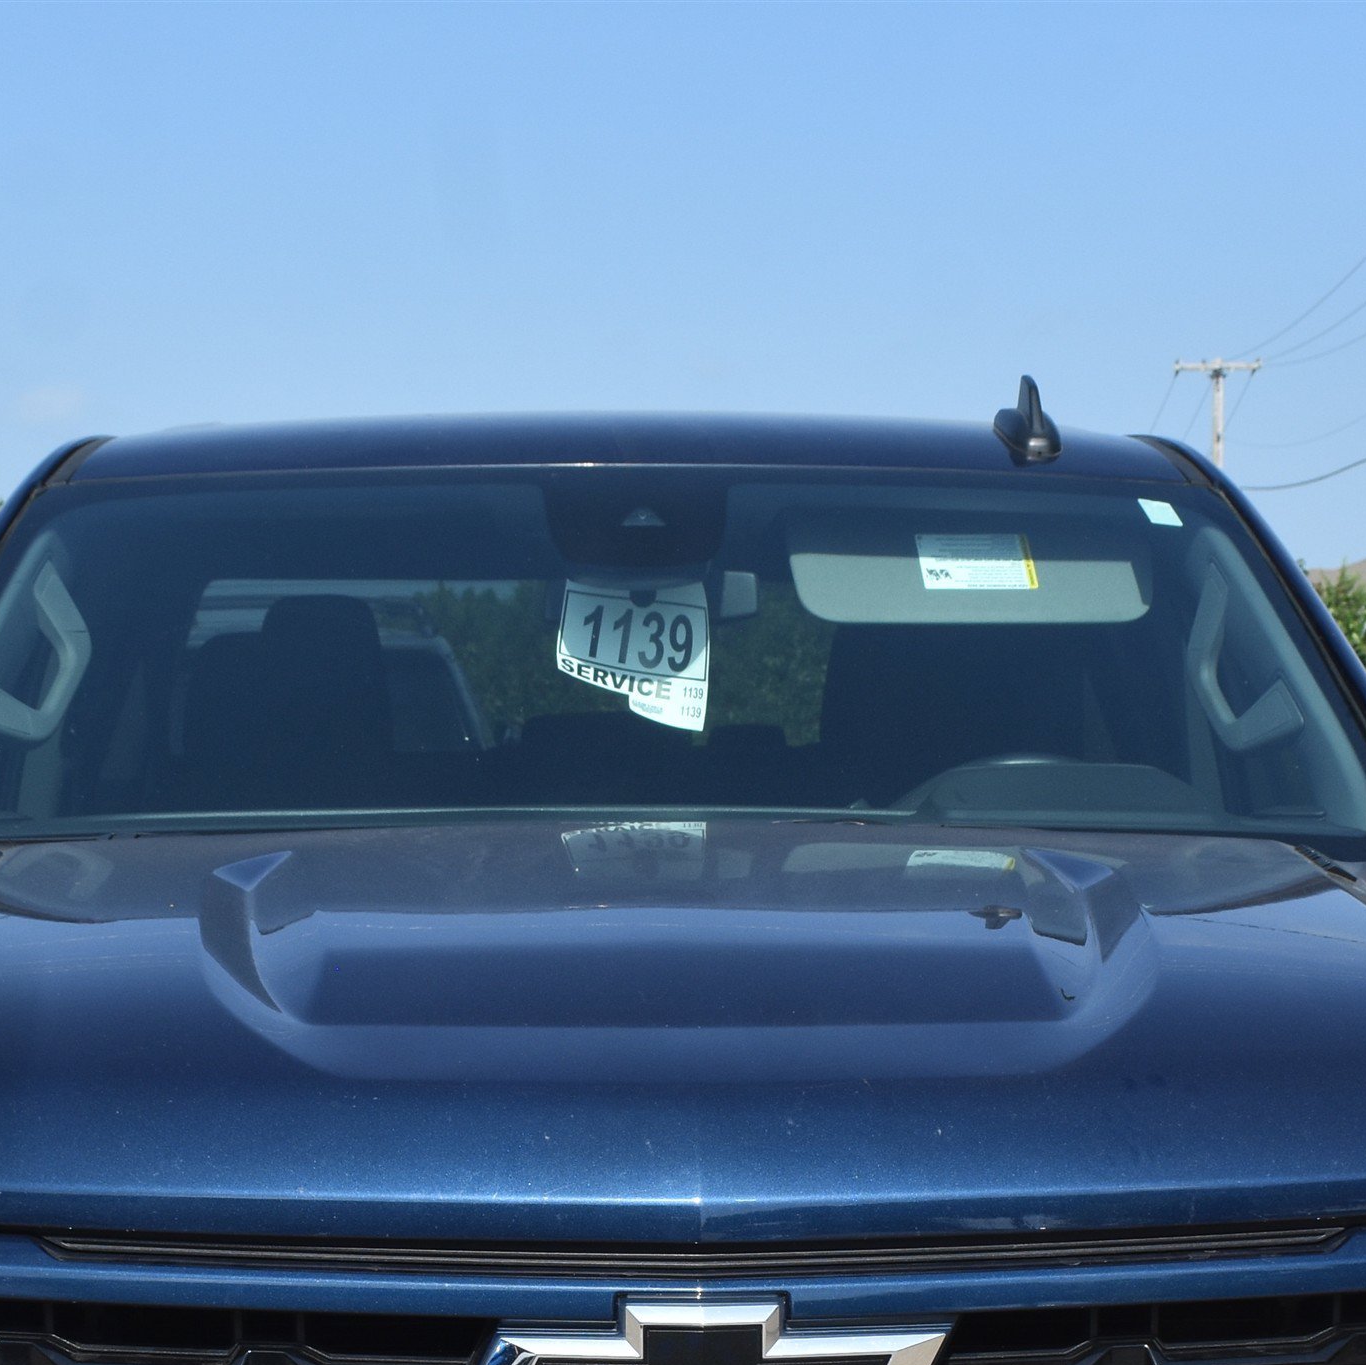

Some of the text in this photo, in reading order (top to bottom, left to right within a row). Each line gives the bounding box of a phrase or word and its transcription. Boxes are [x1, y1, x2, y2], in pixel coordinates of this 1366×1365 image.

[583, 604, 693, 672] 1139
[561, 658, 672, 700] SERVICE
[683, 686, 704, 699] 1139
[681, 706, 701, 718] 1139
